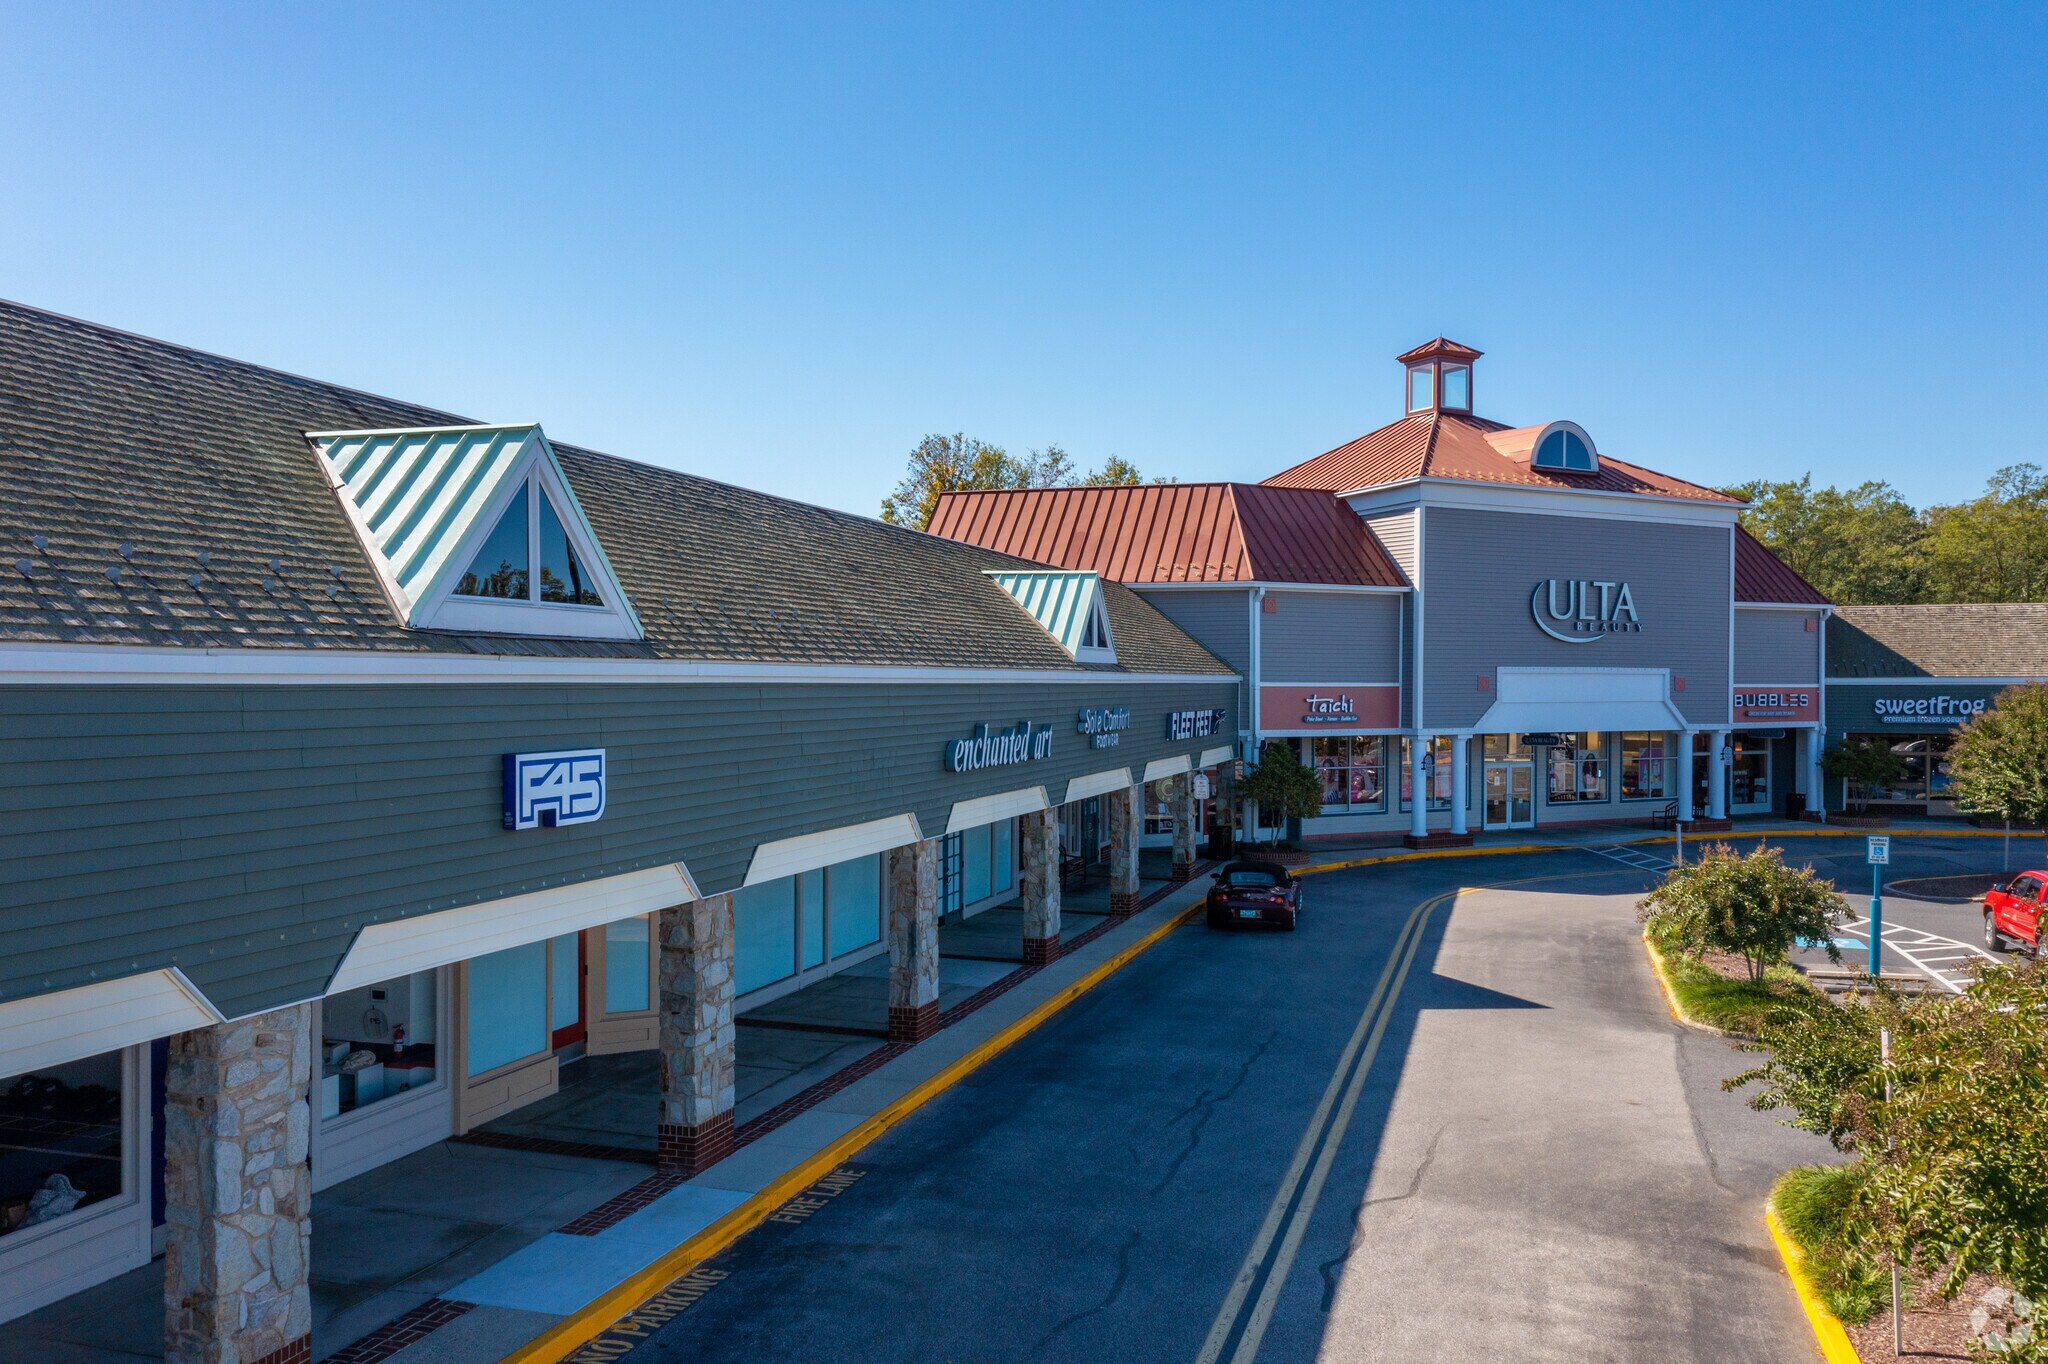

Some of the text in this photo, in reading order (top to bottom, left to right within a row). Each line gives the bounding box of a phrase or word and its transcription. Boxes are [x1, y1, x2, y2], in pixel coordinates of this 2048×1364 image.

[1549, 579, 1639, 621] ULTA
[1576, 622, 1644, 632] BEAUTY
[1306, 694, 1353, 713] Taichi
[1734, 693, 1809, 707] BUBBLES
[1874, 696, 1986, 715] sweetFrog
[1085, 708, 1130, 734] Sole Comfort
[1171, 709, 1213, 741] FLEET FEET
[1883, 714, 1967, 723] premium frozen yogurt
[954, 720, 1053, 773] enchanted art
[522, 759, 600, 818] F45
[769, 1169, 867, 1224] FIRE LANE
[570, 1268, 732, 1364] NO PARKING
